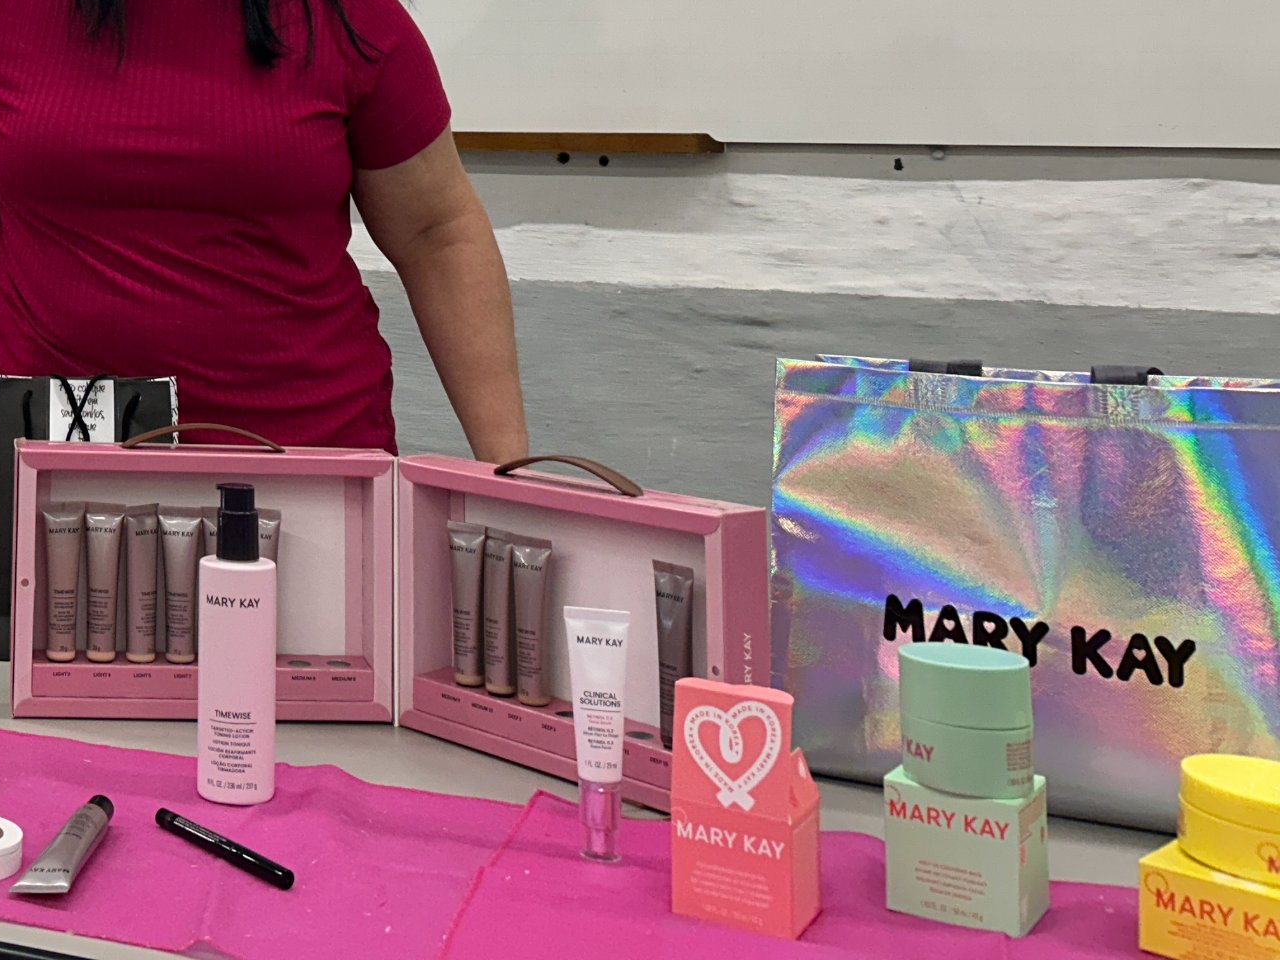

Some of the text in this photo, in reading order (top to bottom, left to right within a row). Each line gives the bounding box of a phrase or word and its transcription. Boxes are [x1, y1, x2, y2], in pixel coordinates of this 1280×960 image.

[260, 533, 272, 541] KAY
[206, 594, 261, 609] MARY KAY
[577, 635, 623, 648] MARY KAY
[744, 632, 752, 660] KAY
[882, 593, 1197, 688] MARY KAY
[579, 697, 622, 708] SOLUTIONS
[583, 690, 618, 700] CLINICAL
[214, 709, 252, 720] TIMEWISE
[690, 710, 710, 724] MADE
[731, 704, 752, 720] MADE
[906, 738, 935, 763] KAY
[888, 799, 1010, 841] MARY KAY
[676, 819, 785, 860] MARY KAY
[1155, 888, 1234, 927] MARY
